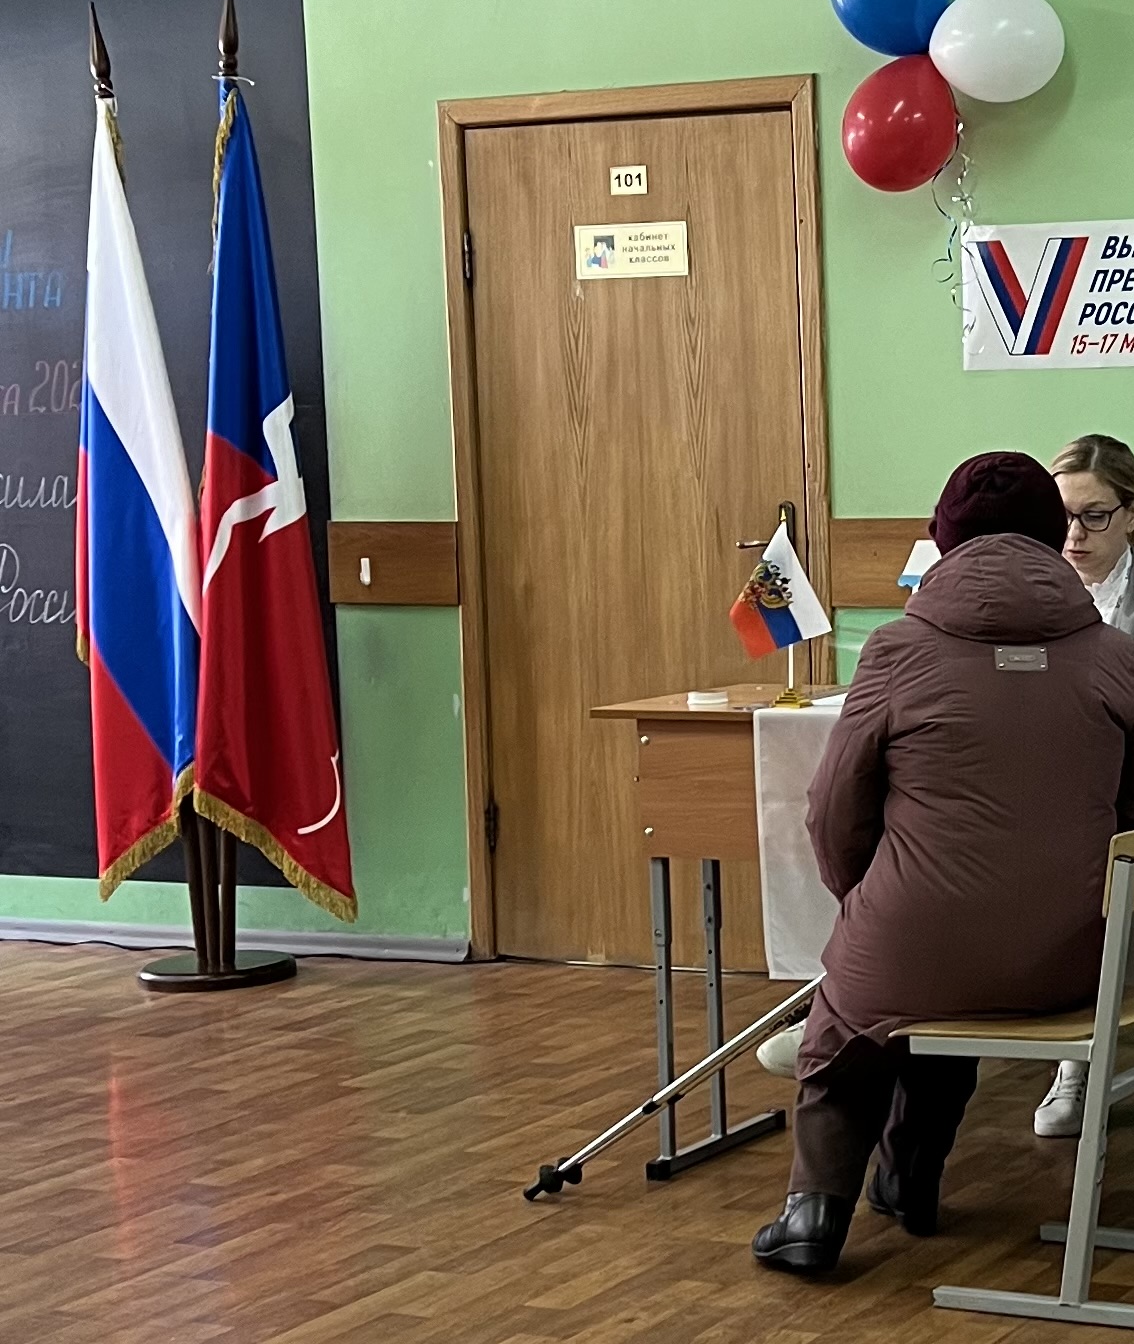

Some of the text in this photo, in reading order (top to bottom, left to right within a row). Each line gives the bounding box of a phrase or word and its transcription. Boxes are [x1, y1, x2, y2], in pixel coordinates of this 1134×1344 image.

[614, 172, 642, 188] 101
[628, 232, 668, 241] кабинет
[622, 244, 676, 253] начальных
[629, 255, 670, 263] классов
